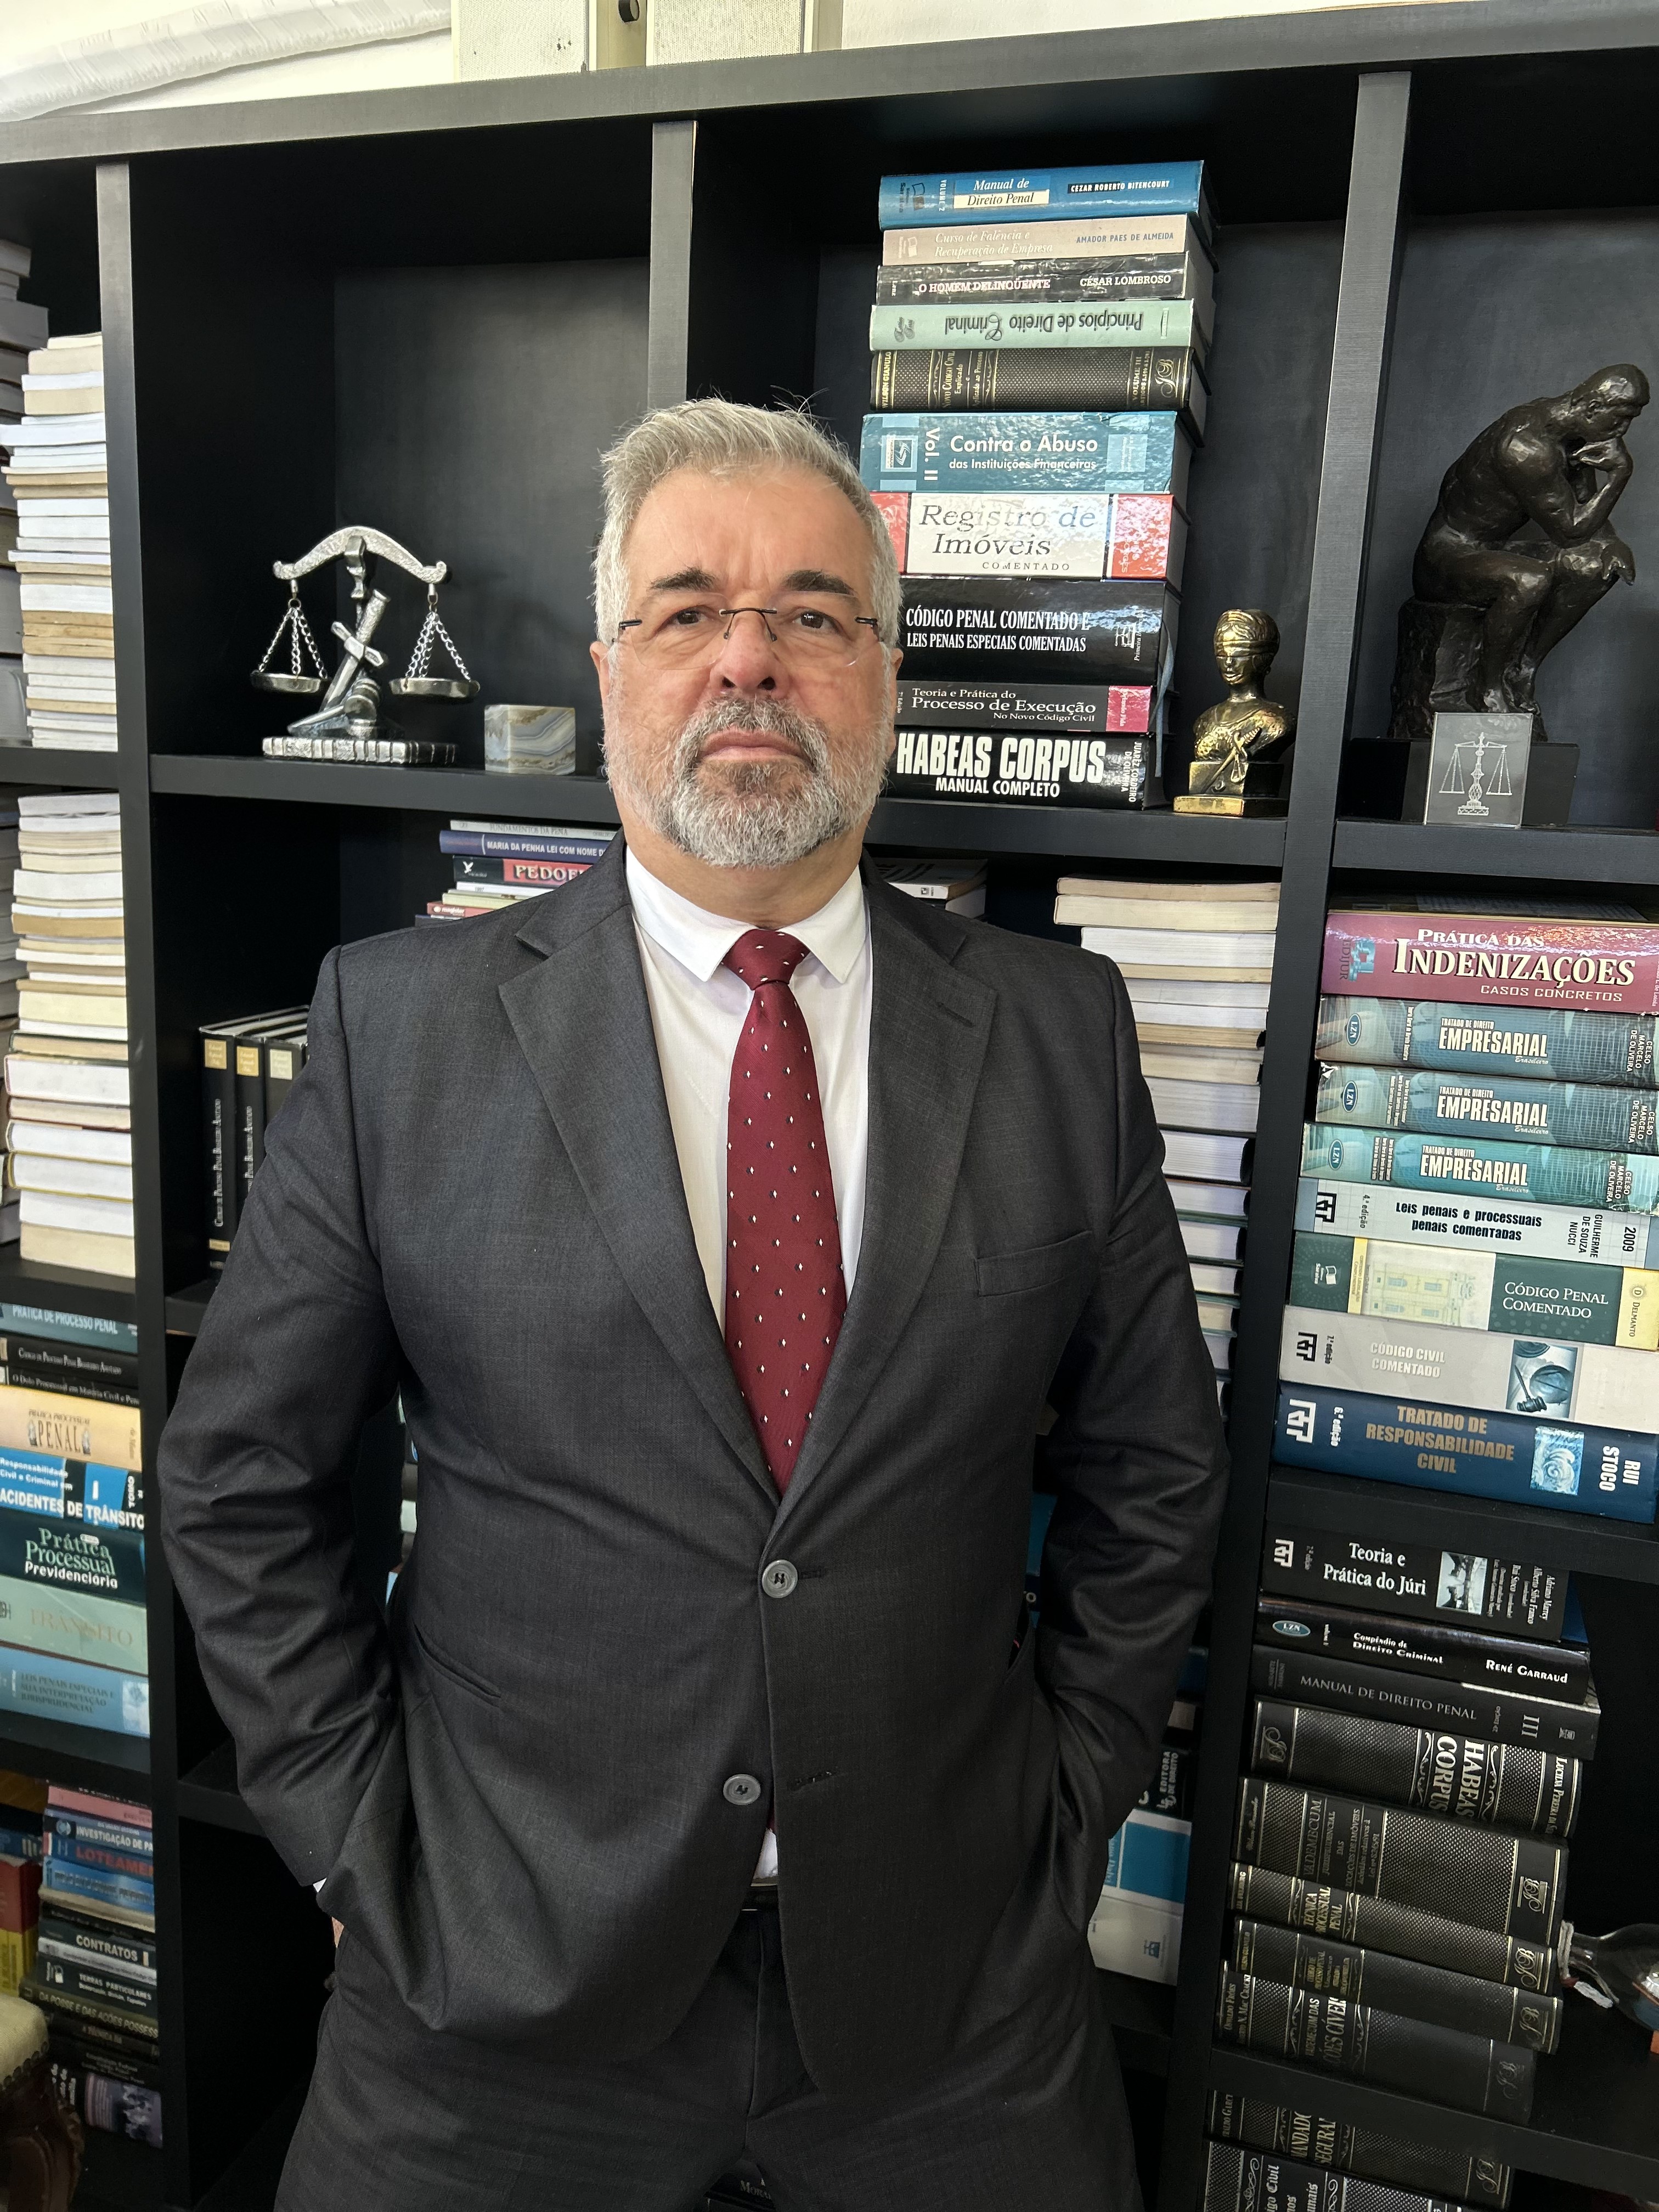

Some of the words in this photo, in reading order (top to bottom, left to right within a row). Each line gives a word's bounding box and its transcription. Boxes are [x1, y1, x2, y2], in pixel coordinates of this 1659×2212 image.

[974, 179, 1013, 191] Manual
[1017, 178, 1029, 188] de
[1127, 180, 1170, 189] BITENCOURT
[967, 195, 1002, 206] Direito
[1006, 193, 1034, 204] Penal
[935, 233, 963, 243] Curso
[967, 232, 978, 242] de
[980, 230, 1021, 241] Falência
[1076, 235, 1106, 244] AMADOR
[935, 246, 994, 259] Recuperação
[997, 244, 1008, 254] de
[1011, 244, 1053, 256] Empresa
[918, 284, 927, 292] O
[929, 283, 970, 292] HOMEM
[972, 278, 1051, 291] DELINQÜENTE
[1080, 275, 1113, 286] CÉSAR
[1114, 275, 1171, 285] LOMBROSO
[945, 314, 1002, 341] Criminal
[1009, 314, 1054, 333] Direito
[1058, 315, 1074, 332] de
[1079, 310, 1143, 331] Princípios
[883, 351, 891, 381] GIANULO
[955, 364, 963, 394] Explicado
[924, 427, 940, 462] Vol.
[950, 436, 1013, 452] Contra
[1020, 439, 1031, 452] o
[1037, 435, 1098, 452] Abuso
[924, 470, 938, 480] II
[949, 459, 969, 469] das
[972, 459, 1030, 472] Instituições
[1034, 459, 1097, 469] Financeiras
[919, 505, 1046, 532] Registro
[1059, 506, 1096, 527] de
[932, 534, 1051, 555] Imóveis
[983, 562, 1069, 571] COMENTADO
[906, 605, 953, 627] CÓDIGO
[956, 610, 996, 628] PENAL
[1000, 611, 1077, 630] COMENTADO
[1081, 612, 1090, 630] E
[907, 633, 927, 647] LEIS
[930, 634, 964, 648] PENAIS
[967, 635, 1016, 650] ESPECIAIS
[1019, 635, 1086, 652] COMENTADAS
[912, 689, 946, 697] Teoria
[960, 689, 997, 698] Prática
[911, 697, 984, 710] Processo
[989, 699, 1010, 710] de
[1015, 700, 1096, 715] Execução
[1037, 714, 1070, 723] Código
[896, 733, 992, 777] HABEAS
[999, 737, 1106, 783] CORPUS
[935, 777, 989, 793] MANUAL
[992, 780, 1060, 798] COMPLETO
[1128, 769, 1138, 803] CORDEIRO
[487, 841, 509, 851] MARIA
[511, 843, 520, 851] DA
[522, 843, 545, 852] PENHA
[546, 845, 557, 854] LEI
[560, 846, 575, 855] COM
[1418, 928, 1499, 945] PRÁTICA
[1508, 933, 1544, 947] DAS
[1392, 938, 1635, 989] INDENIZAÇÕES
[1481, 985, 1528, 996] CASOS
[1534, 989, 1622, 1002] CONCRETOS
[1441, 1018, 1464, 1027] TRATADO
[1474, 1020, 1494, 1029] DIREITO
[1631, 1030, 1638, 1040] DE
[1439, 1028, 1548, 1057] EMPRESARIAL
[1635, 1035, 1645, 1069] MARCELO
[1644, 1041, 1652, 1064] CELSO
[1515, 1056, 1548, 1064] Brasileiro
[1627, 1041, 1637, 1073] OLIVEIRA
[1440, 1086, 1462, 1096] TRATADO
[1472, 1087, 1493, 1098] DIREITO
[1437, 1096, 1548, 1127] EMPRESARIAL
[1633, 1100, 1639, 1109] DE
[1514, 1125, 1549, 1135] Brasileiro
[1628, 1111, 1638, 1143] OLIVEIRA
[1637, 1105, 1647, 1140] MARCELO
[1646, 1111, 1655, 1135] CELSO
[1423, 1146, 1445, 1155] TRATADO
[1454, 1147, 1475, 1158] DIREITO
[1420, 1154, 1528, 1186] EMPRESARIAL
[1610, 1160, 1617, 1170] DE
[1496, 1184, 1528, 1193] Brasileiro
[1605, 1171, 1615, 1203] OLIVEIRA
[1615, 1165, 1624, 1199] MARCELO
[1623, 1171, 1632, 1195] CELSO
[1360, 1205, 1368, 1228] edição
[1396, 1203, 1417, 1214] Leis
[1422, 1204, 1458, 1218] penais
[1463, 1210, 1469, 1218] e
[1475, 1210, 1542, 1227] processuais
[1412, 1220, 1447, 1233] penais
[1582, 1216, 1590, 1226] DE
[1567, 1222, 1578, 1246] NUCCI
[1578, 1227, 1590, 1253] SOUZA
[1590, 1214, 1603, 1259] GUILHERME
[1623, 1227, 1637, 1252] 2009
[1504, 1282, 1560, 1299] CÓDIGO
[1563, 1288, 1609, 1305] PENAL
[1503, 1297, 1592, 1318] COMENTADO
[94, 1318, 118, 1334] PENAL
[1629, 1302, 1640, 1338] DELMANTO
[1370, 1343, 1413, 1358] CÓDIGO
[1416, 1348, 1445, 1363] CIVIL
[1372, 1358, 1441, 1378] COMENTADO
[1397, 1406, 1464, 1431] TRATADO
[1468, 1417, 1487, 1434] DE
[37, 1420, 81, 1453] PENAL
[1366, 1423, 1515, 1461] RESPONSABILIDADE
[0, 1457, 69, 1479] Responsabilidade
[1417, 1453, 1457, 1474] CIVIL
[1599, 1446, 1620, 1492] STOCO
[1623, 1460, 1641, 1485] RUI
[0, 1469, 16, 1480] Civil
[26, 1474, 58, 1487] Criminal
[60, 1481, 73, 1492] em
[0, 1488, 64, 1515] ACIDENTES
[67, 1500, 83, 1517] DE
[86, 1504, 144, 1530] TRÂNSITO
[38, 1527, 110, 1558] Prática
[25, 1539, 115, 1576] Processual
[1349, 1542, 1392, 1565] Teoria
[1397, 1554, 1406, 1567] e
[25, 1561, 118, 1589] Previdenciária
[1323, 1564, 1372, 1587] Prática
[1376, 1572, 1395, 1590] do
[1396, 1576, 1426, 1596] Júri
[1300, 1675, 1354, 1695] MANUAL
[1358, 1687, 1375, 1699] DE
[1379, 1691, 1432, 1711] DIREITO
[1437, 1702, 1476, 1720] PENAL
[1428, 1736, 1457, 1810] CORPUS
[1456, 1740, 1485, 1818] HABEAS
[76, 1826, 131, 1847] INVESTIGAÇÃO
[133, 1839, 142, 1850] DE
[1302, 1799, 1322, 1875] VADEMECUM
[76, 1934, 138, 1962] CONTRATOS
